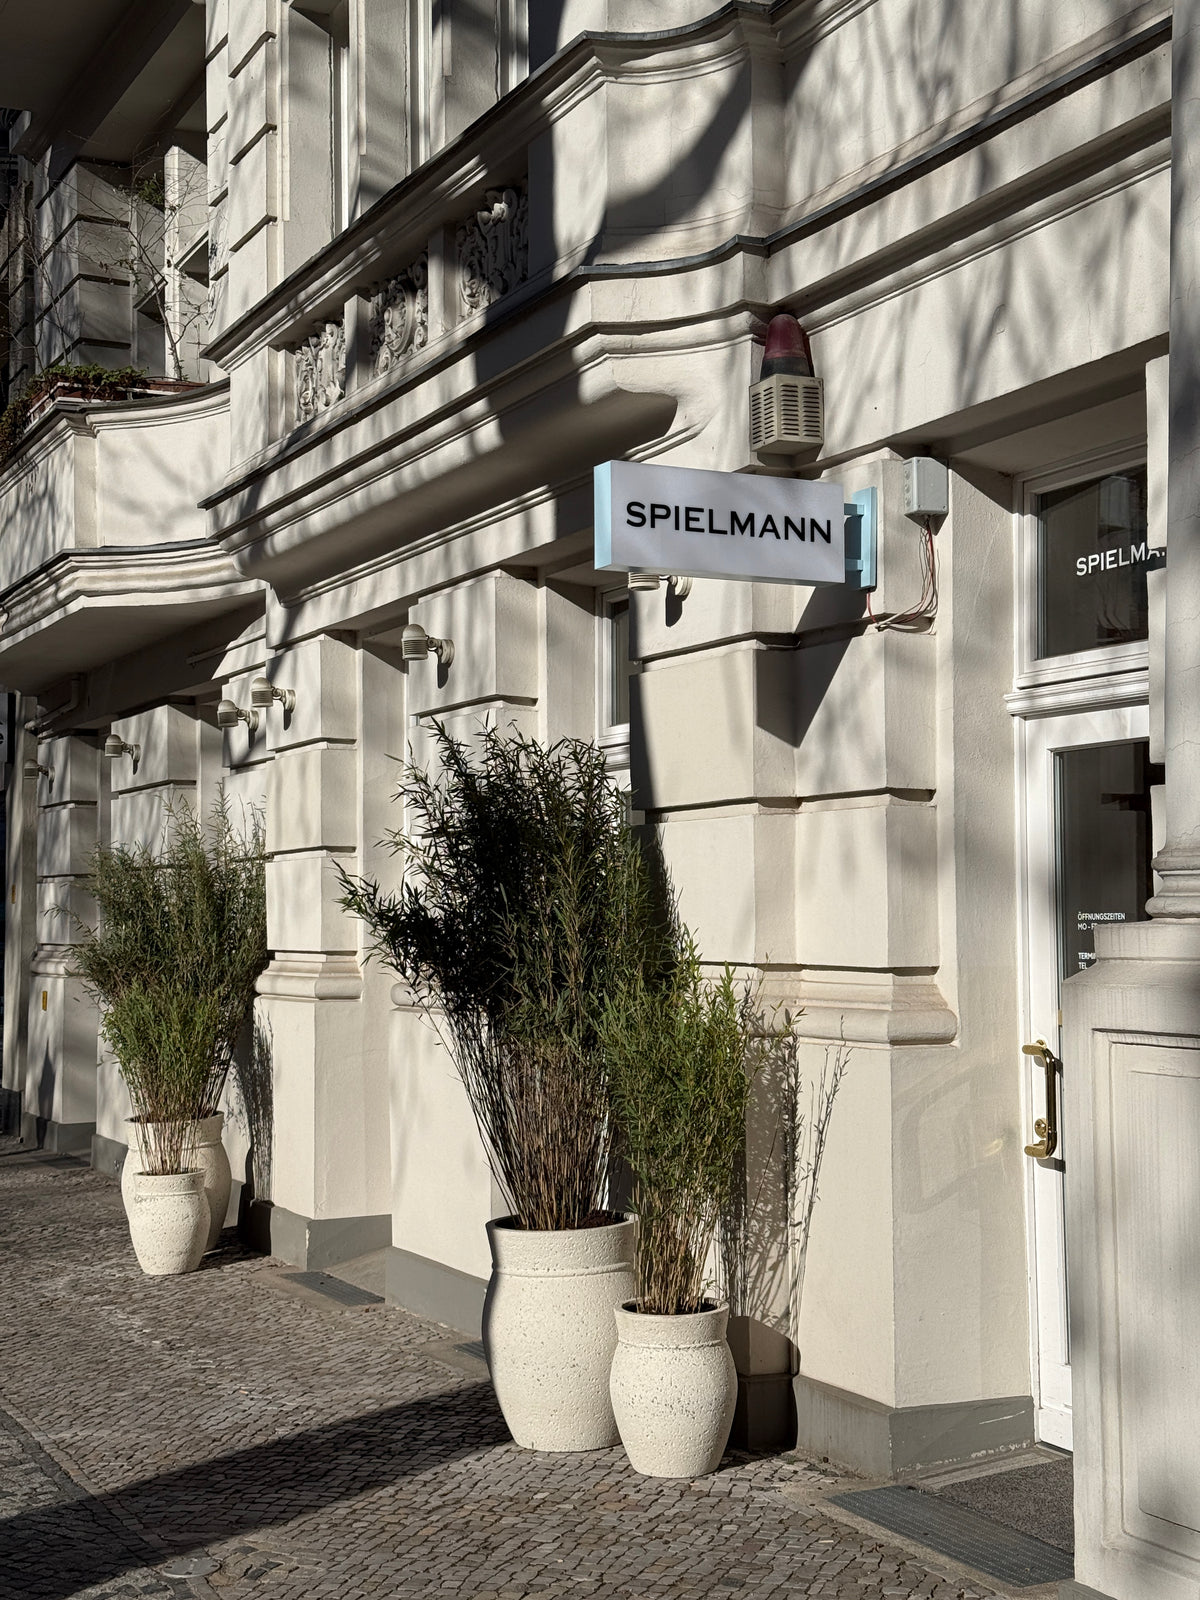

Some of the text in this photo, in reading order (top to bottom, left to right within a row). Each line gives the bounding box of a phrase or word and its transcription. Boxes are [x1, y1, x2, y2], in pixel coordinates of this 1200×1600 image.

[626, 501, 831, 544] SPIELMANN
[1076, 542, 1165, 576] SPIELMA
[1077, 911, 1126, 921] ÖFFNUNGSZEITEN
[1077, 922, 1088, 930] MO
